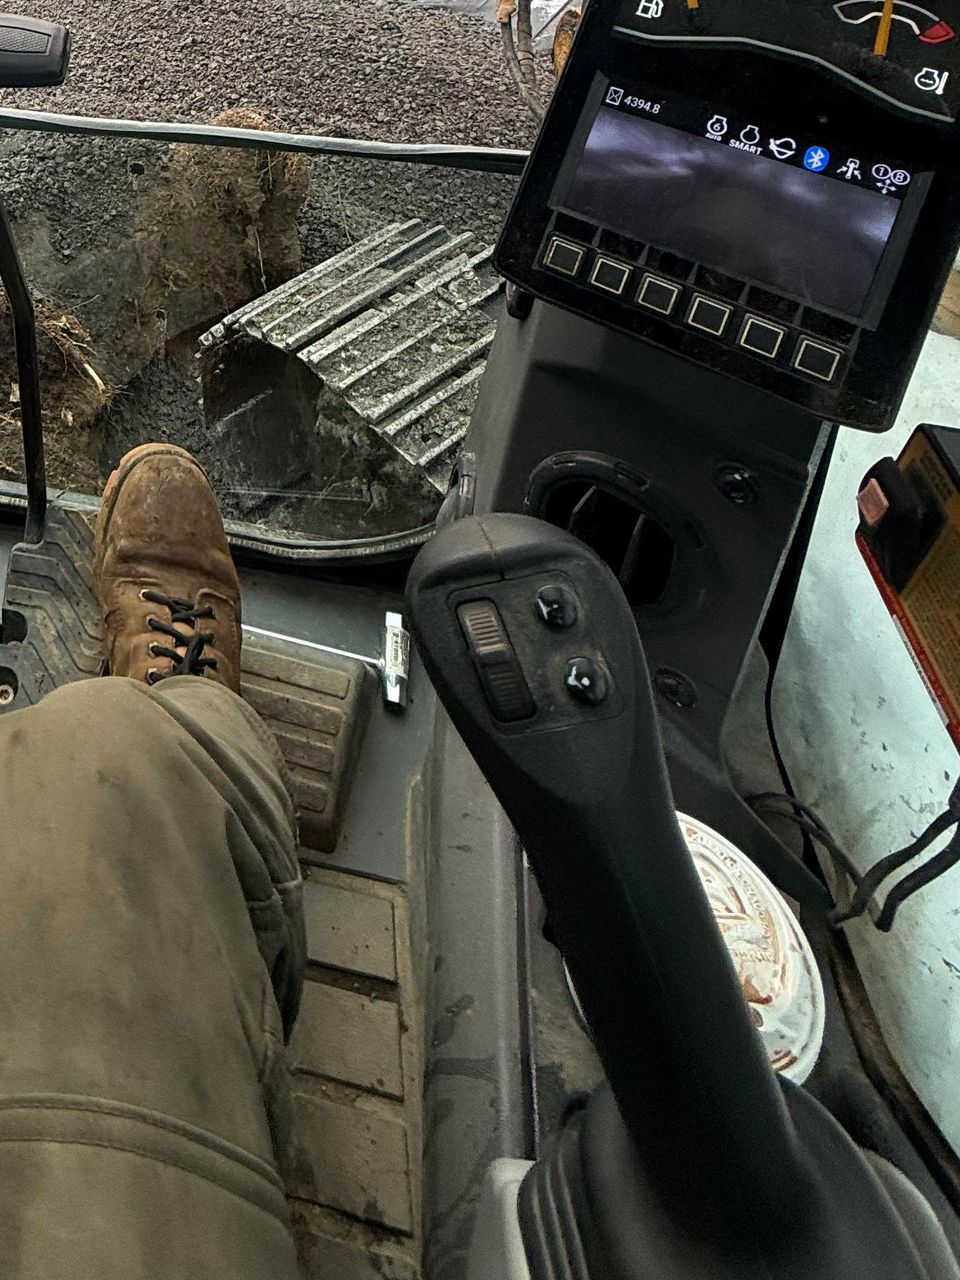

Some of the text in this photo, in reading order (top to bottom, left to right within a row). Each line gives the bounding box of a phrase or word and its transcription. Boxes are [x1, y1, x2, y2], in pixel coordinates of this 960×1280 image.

[623, 95, 661, 114] 4394.8
[713, 123, 721, 131] 6
[729, 139, 763, 155] SMART
[896, 172, 904, 181] B
